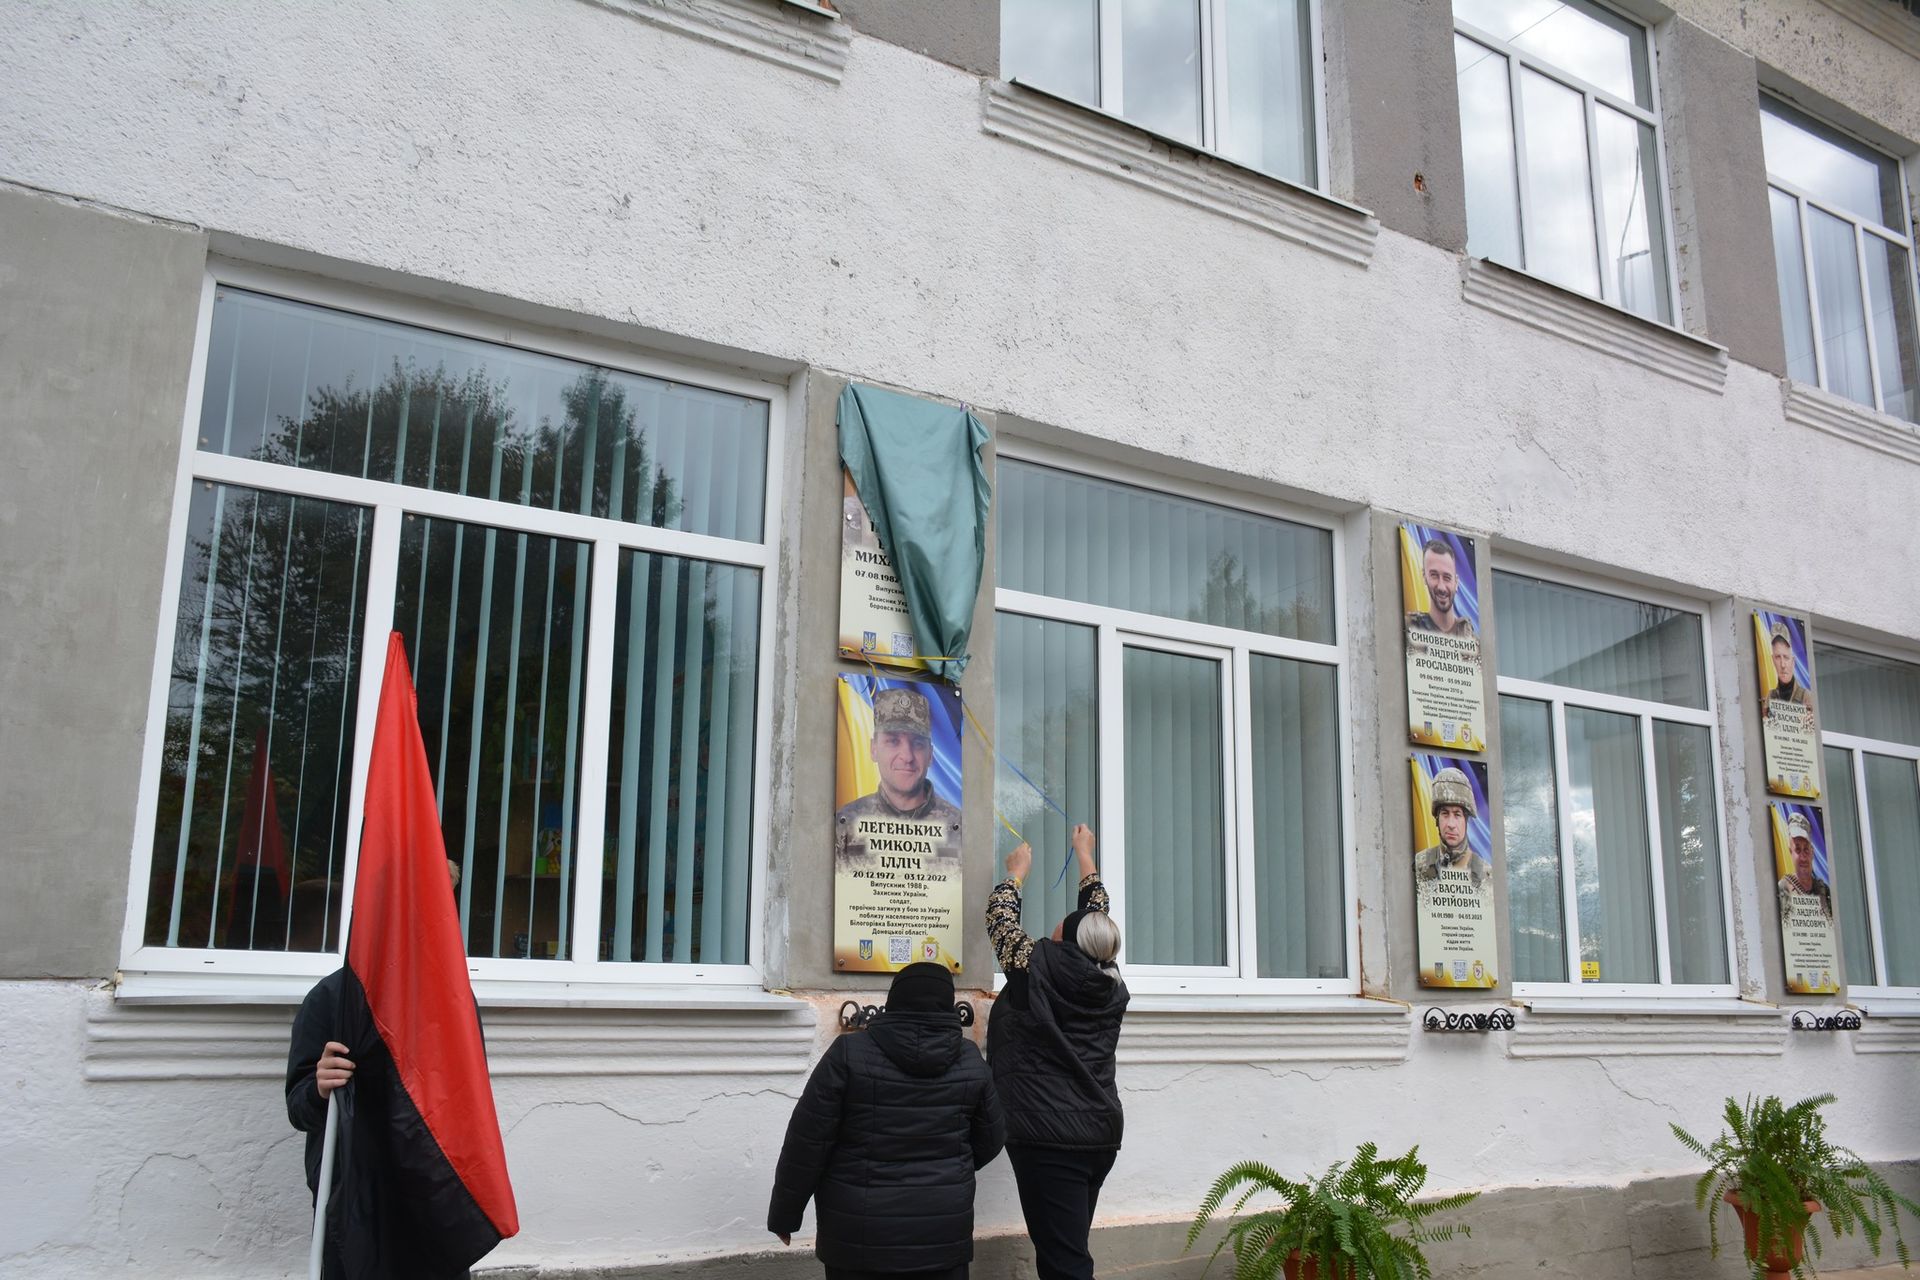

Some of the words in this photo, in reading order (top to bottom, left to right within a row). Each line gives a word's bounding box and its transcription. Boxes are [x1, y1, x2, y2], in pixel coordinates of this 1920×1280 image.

[1412, 632, 1476, 651] СИНОВЕРСЬКИЙ
[1430, 648, 1459, 661] АНДРІЙ
[1416, 658, 1474, 676] ЯРОСЛАВОВИЧ
[1771, 702, 1806, 714] ЛЕГЕНЬКИХ
[1778, 713, 1801, 723] ВАСИЛЬ
[859, 821, 942, 837] ЛЕГЕНЬКИХ
[870, 839, 932, 853] МИКОЛА
[881, 856, 921, 869] ІЛЛІЧ
[853, 871, 895, 880] 20.12.1972
[1442, 871, 1469, 881] ЗІНИК
[870, 881, 905, 889] Випускник
[1439, 884, 1473, 894] ВАСИЛЬ
[873, 889, 901, 897] Захисник
[1433, 895, 1480, 908] ЮРІЙОВИЧ
[1793, 897, 1820, 906] ПАВЛЮК
[1797, 907, 1819, 917] АНДРІЙ
[1792, 919, 1827, 928] ТАРАСОВИЧ
